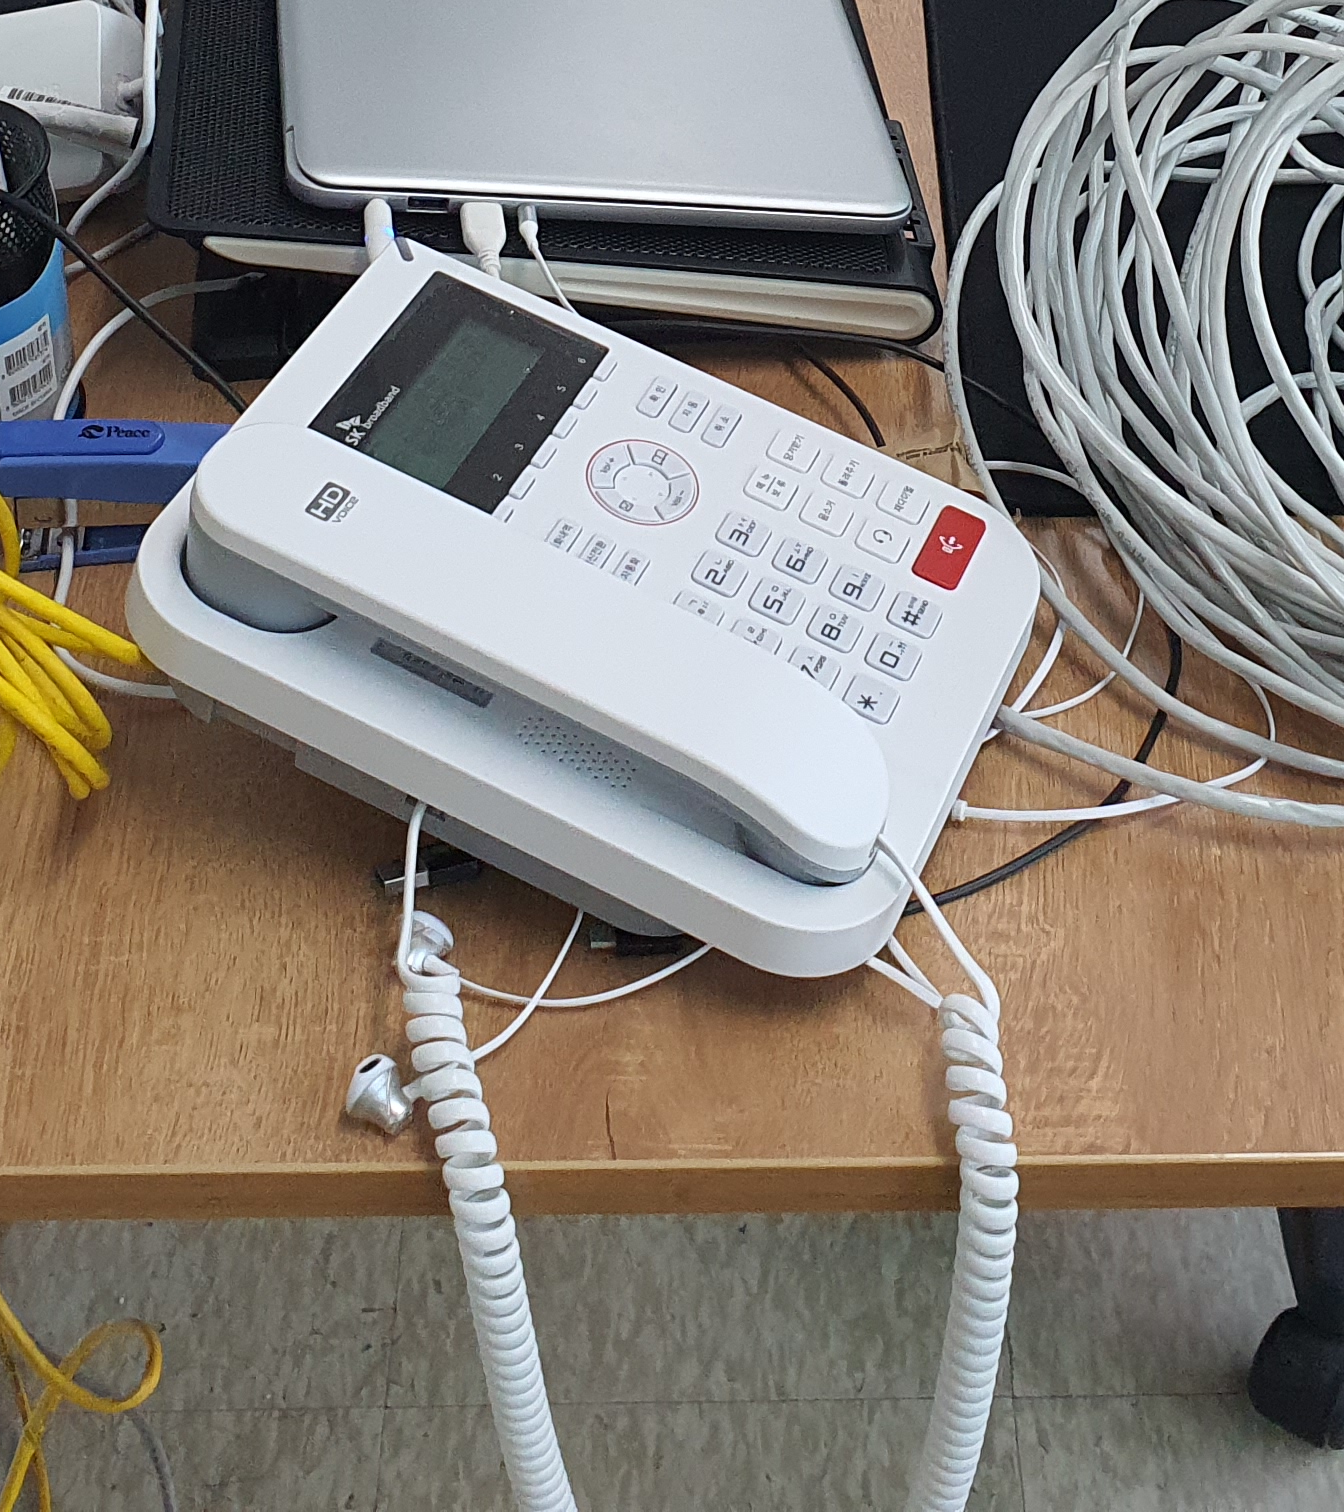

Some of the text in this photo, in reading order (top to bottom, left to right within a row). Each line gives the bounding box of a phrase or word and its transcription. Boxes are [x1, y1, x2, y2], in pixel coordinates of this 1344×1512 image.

[344, 385, 401, 447] SK broadband
[106, 425, 151, 439] Peace
[309, 486, 344, 519] HD
[331, 495, 360, 524] VOICE
[817, 499, 836, 522] 음소거
[728, 527, 750, 547] 3
[785, 553, 807, 573] 6
[705, 567, 727, 586] 2
[843, 581, 864, 601] 9
[762, 594, 785, 614] 5
[820, 622, 842, 641] 8
[878, 649, 900, 669] 0
